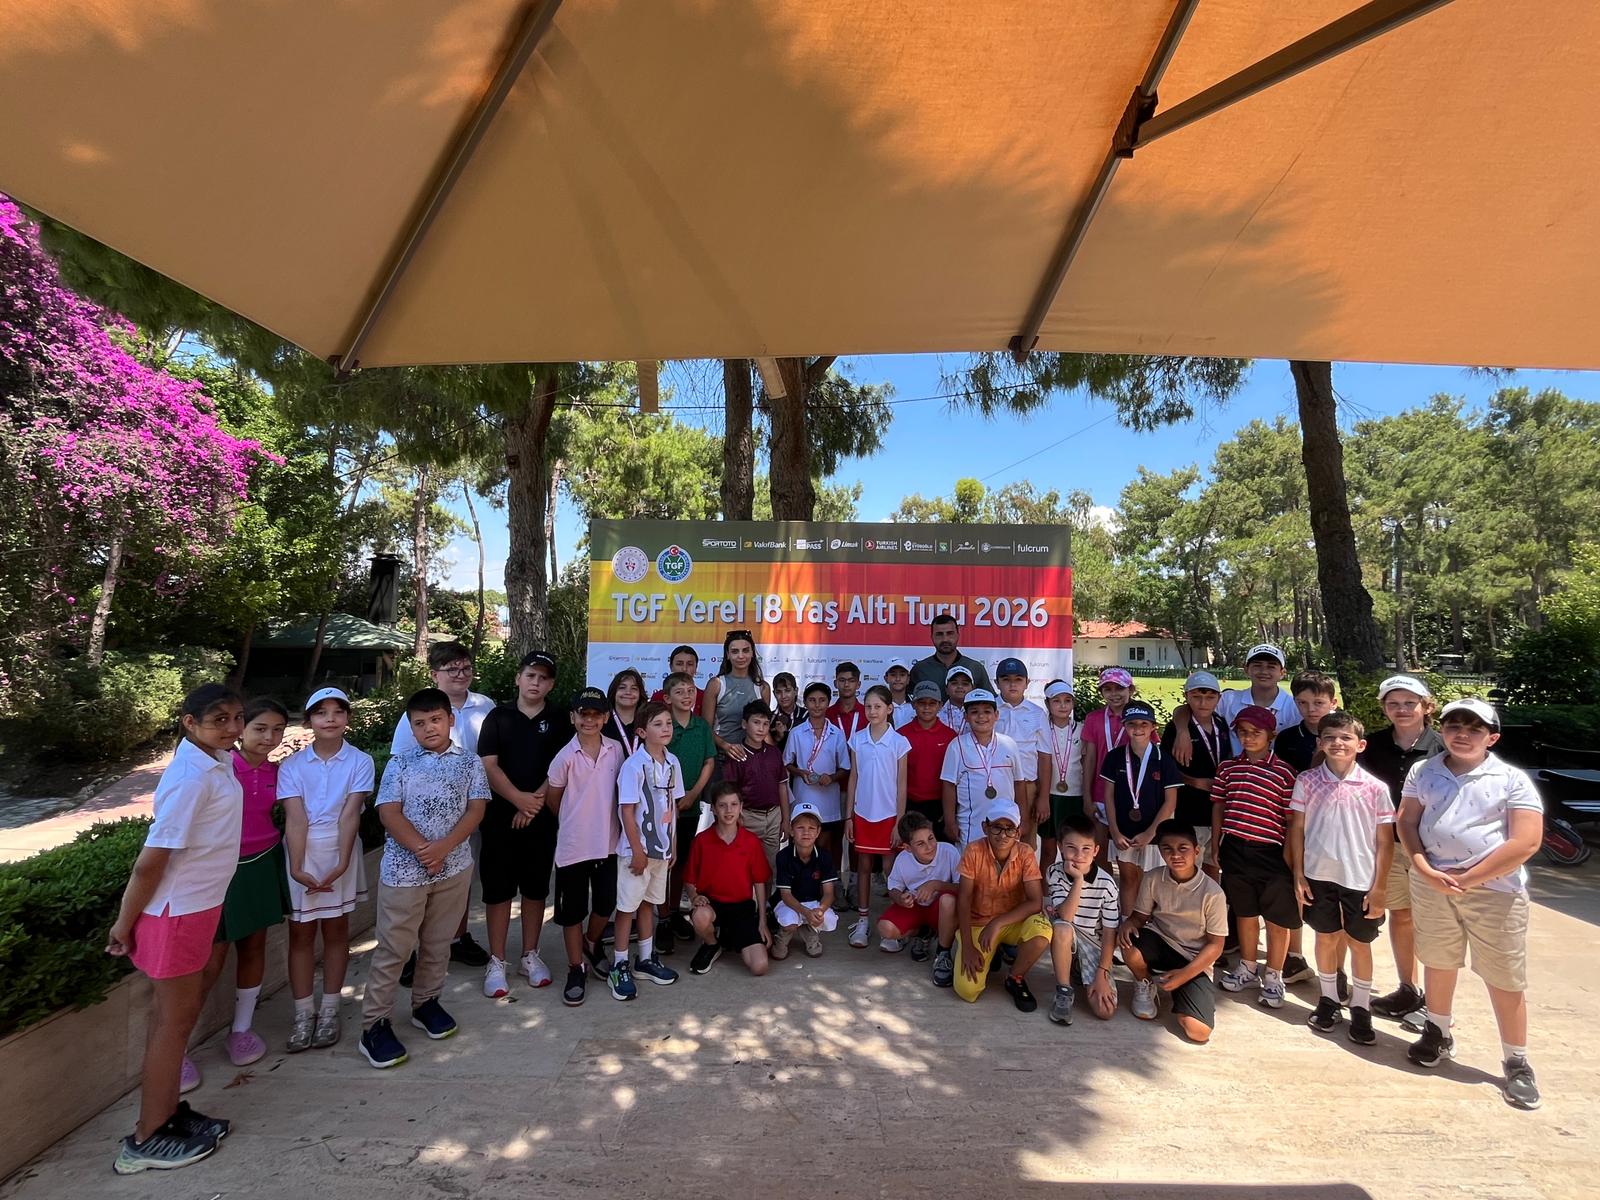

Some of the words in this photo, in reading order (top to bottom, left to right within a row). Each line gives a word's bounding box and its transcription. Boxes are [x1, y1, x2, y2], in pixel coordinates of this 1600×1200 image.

[1017, 543, 1049, 553] fulcrum
[665, 562, 683, 570] TGF
[611, 592, 667, 624] TGF
[673, 592, 745, 624] Yerel
[751, 593, 783, 625] 18
[790, 593, 839, 631] Yaş
[846, 594, 896, 626] Altı
[903, 595, 966, 627] Turu
[974, 596, 1050, 629] 2026
